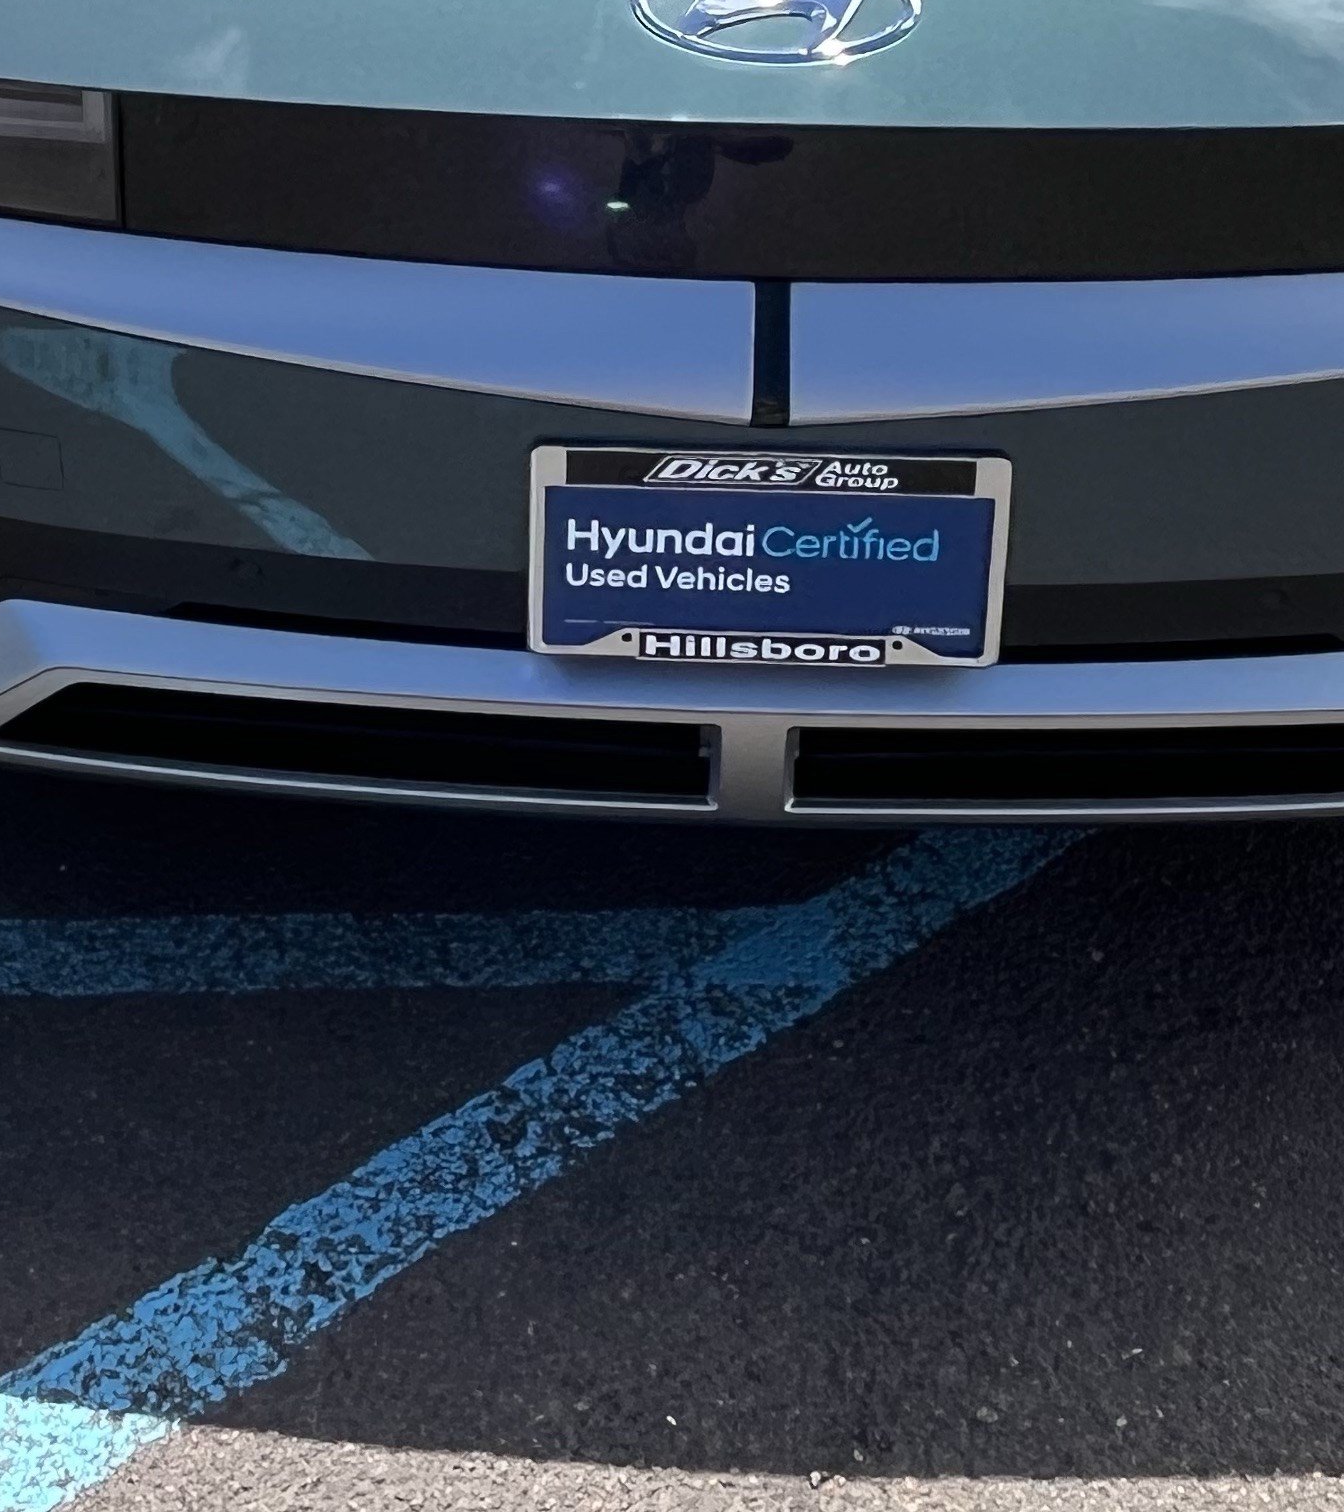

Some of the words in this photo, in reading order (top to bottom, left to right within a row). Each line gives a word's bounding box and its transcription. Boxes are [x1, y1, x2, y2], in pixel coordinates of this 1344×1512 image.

[657, 459, 803, 482] Dick's
[815, 473, 899, 490] Group
[823, 461, 888, 477] Auto
[566, 518, 755, 559] Hyundai
[761, 518, 940, 562] Certified
[565, 562, 648, 588] Used
[654, 565, 791, 594] Vehicles
[645, 634, 881, 662] Hillsboro
